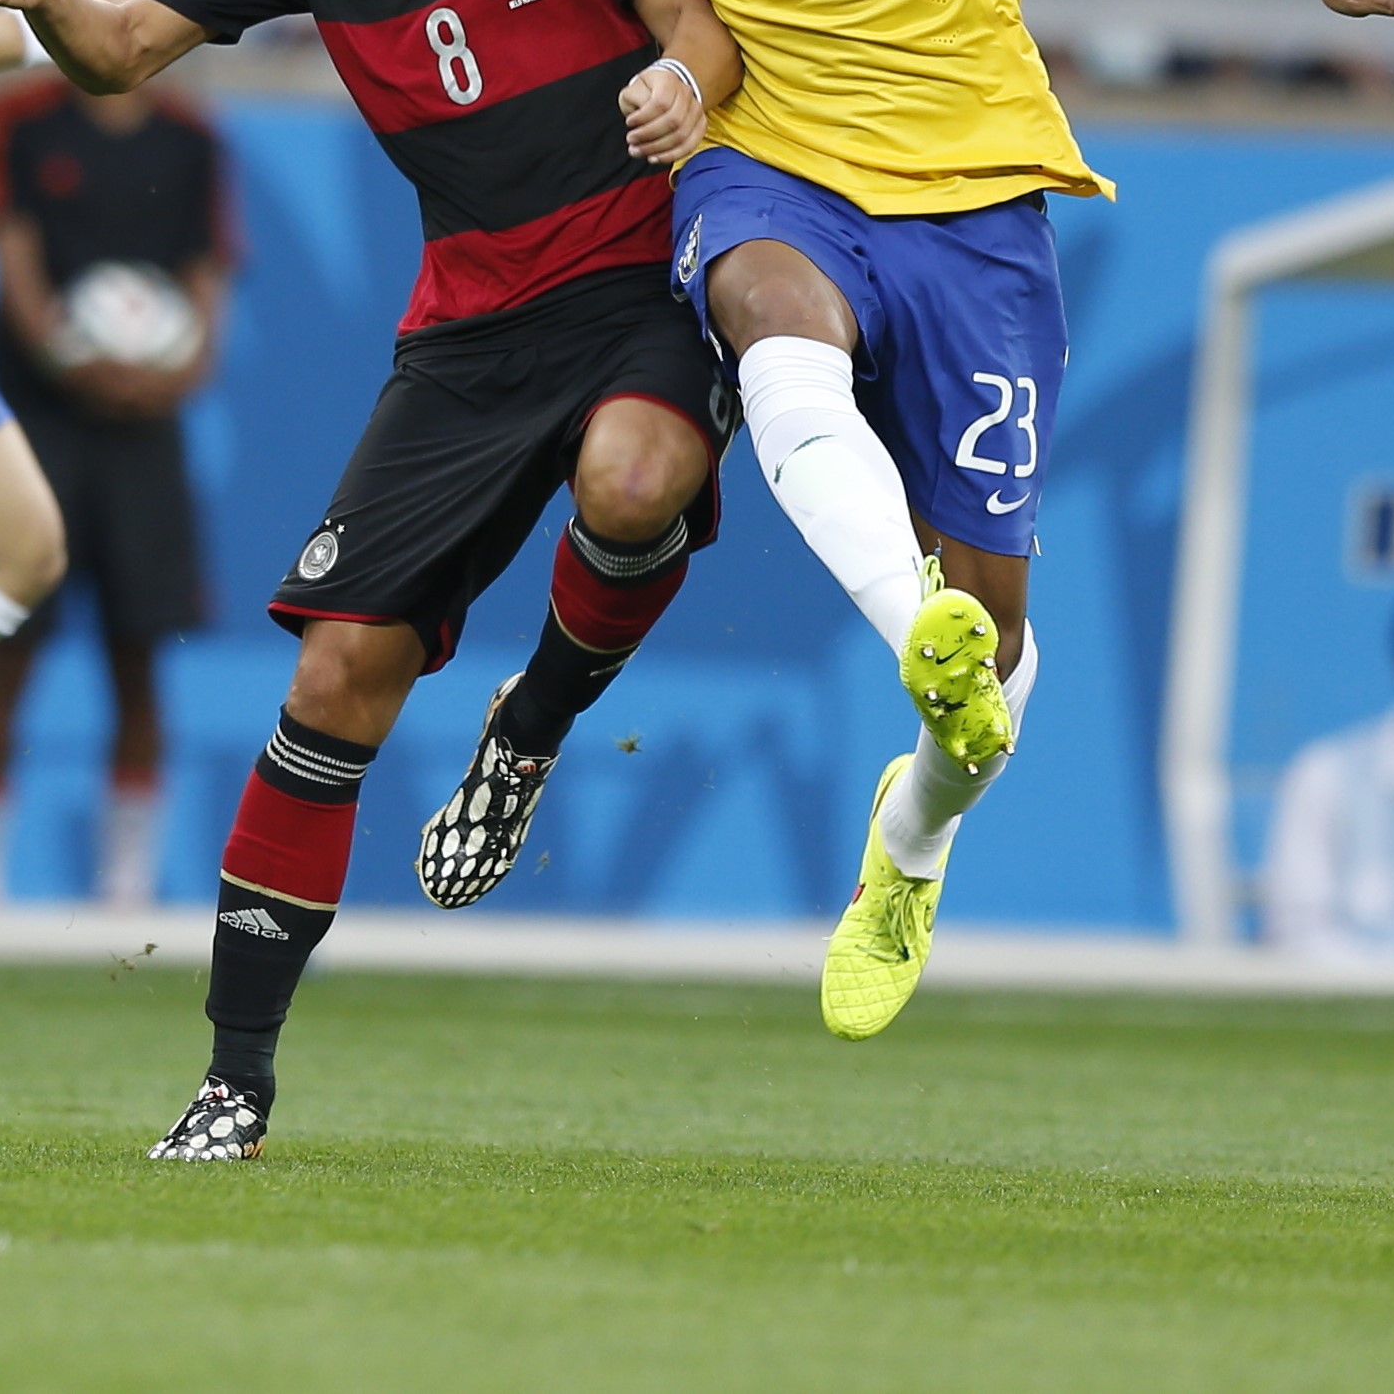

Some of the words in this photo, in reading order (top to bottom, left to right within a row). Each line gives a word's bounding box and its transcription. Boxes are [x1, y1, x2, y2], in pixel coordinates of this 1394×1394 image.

[425, 7, 483, 105] 8
[955, 372, 1037, 478] 23
[219, 912, 290, 941] adidas
